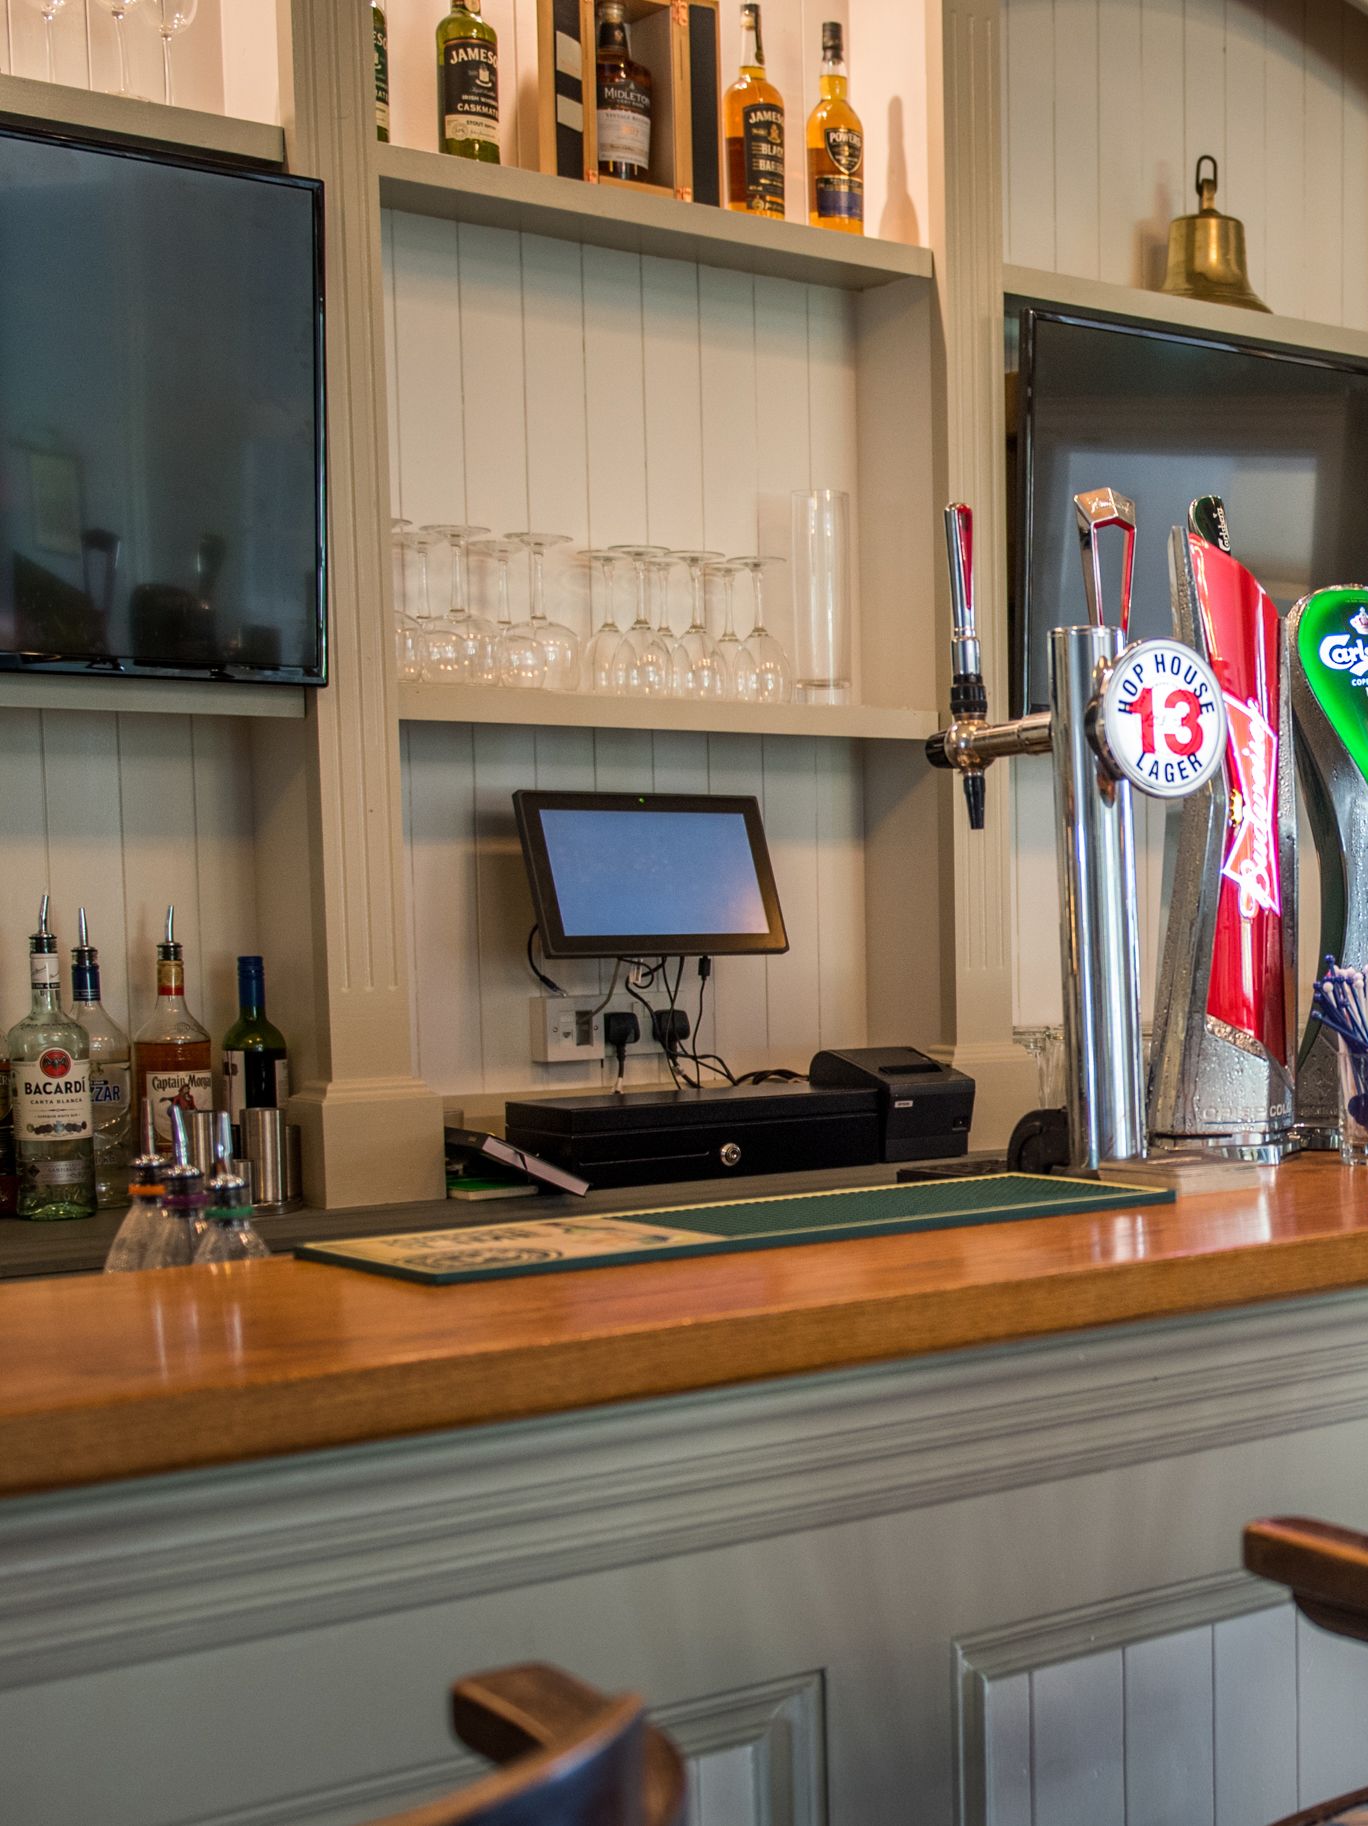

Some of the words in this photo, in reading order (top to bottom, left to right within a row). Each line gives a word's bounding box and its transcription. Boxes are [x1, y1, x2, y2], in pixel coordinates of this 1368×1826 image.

[1117, 663, 1145, 715] HOP
[1154, 653, 1215, 716] HOUSE
[1128, 687, 1204, 756] 13
[1136, 751, 1203, 783] LAGER
[24, 1076, 86, 1095] BACARDÍ
